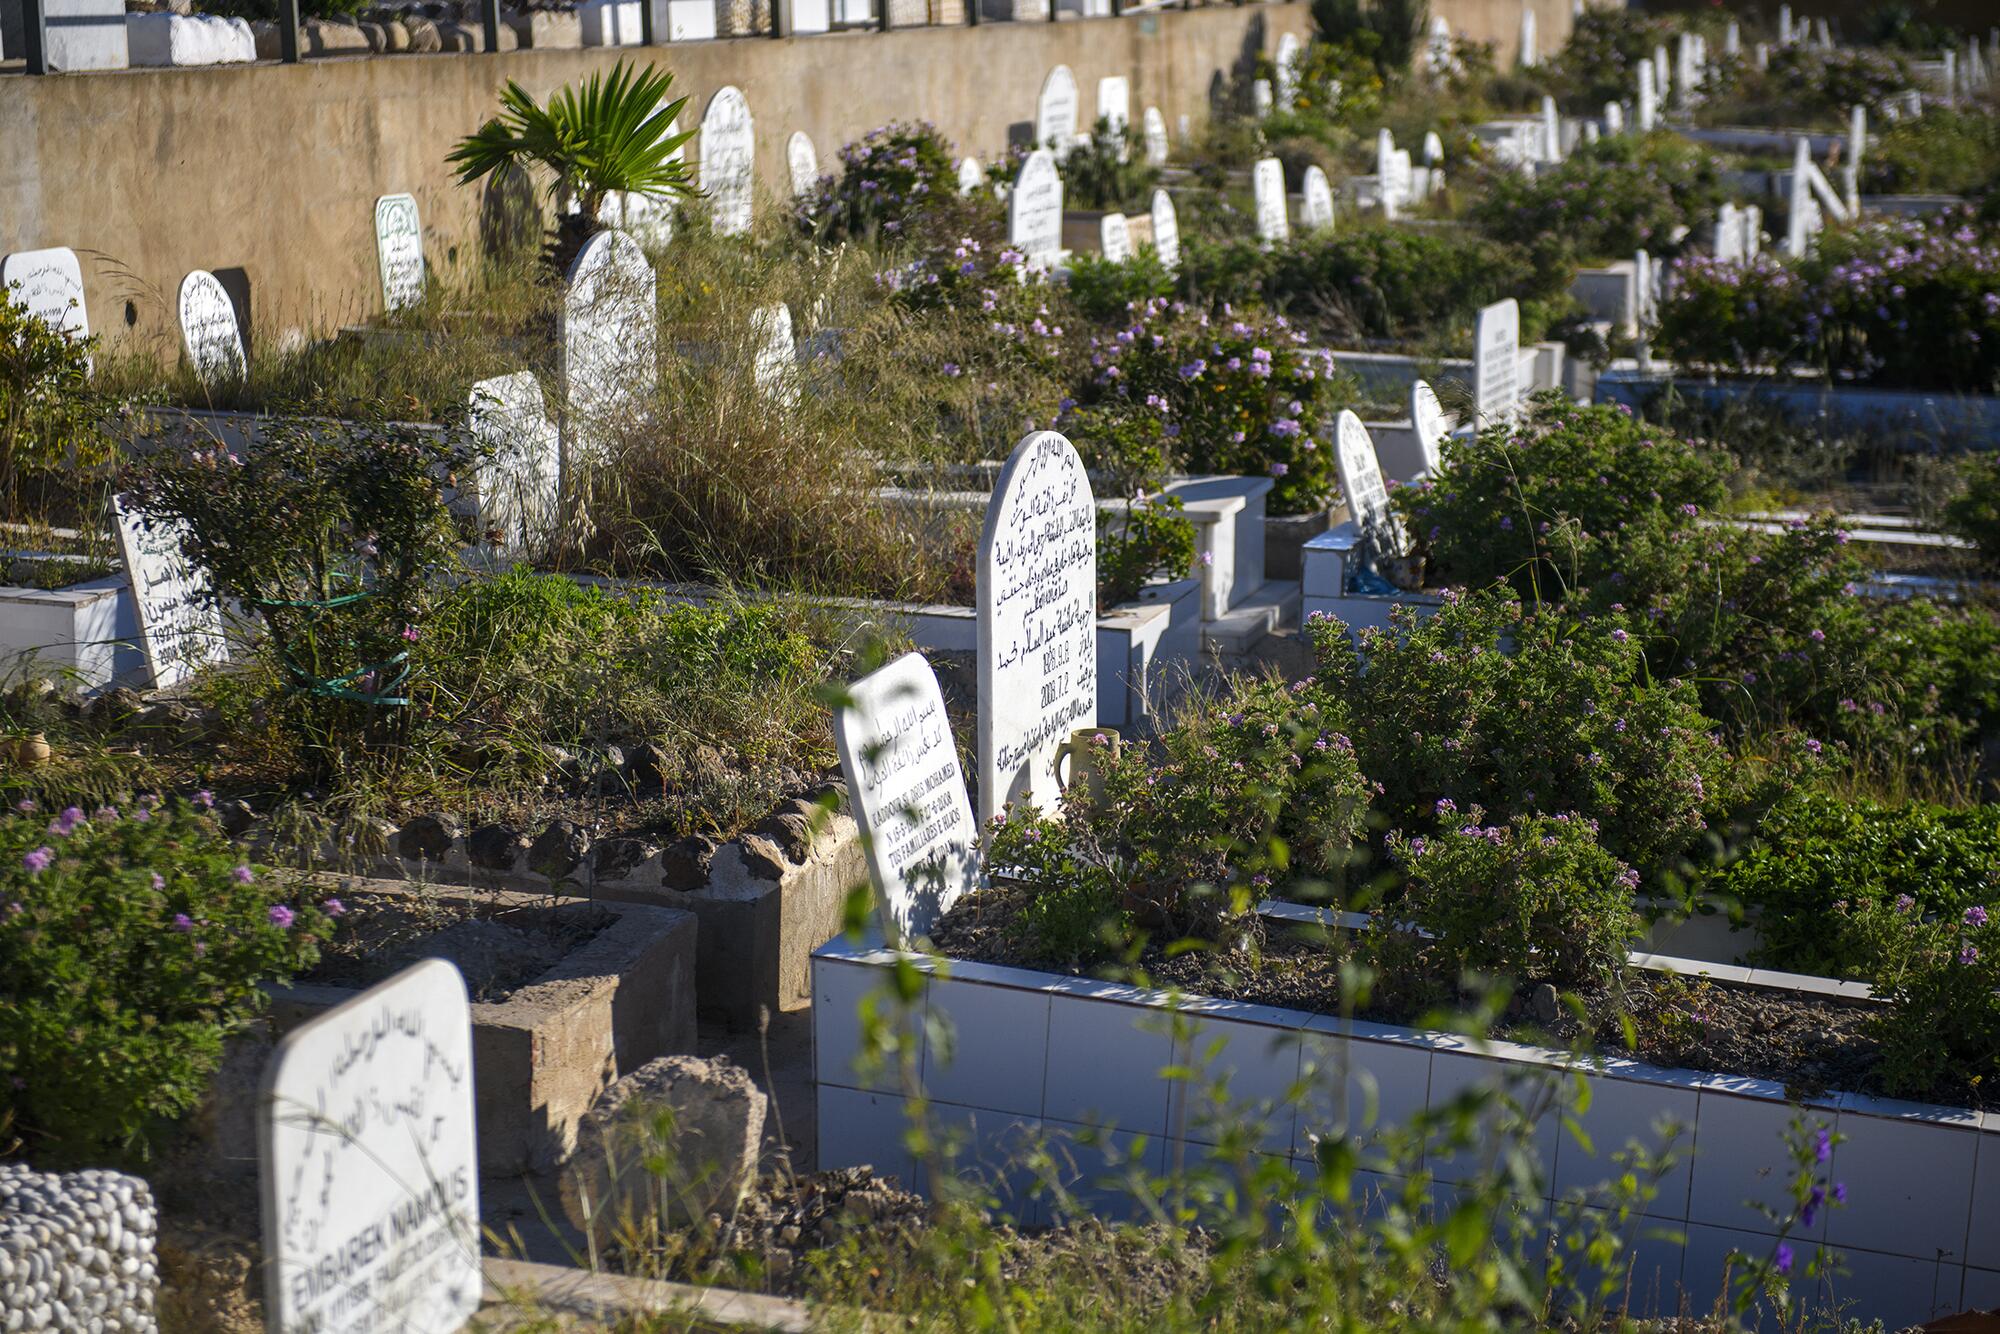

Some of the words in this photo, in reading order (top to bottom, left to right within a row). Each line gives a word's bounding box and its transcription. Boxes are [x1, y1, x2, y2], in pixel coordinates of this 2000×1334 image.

[1041, 671, 1069, 709] 2008.7.2
[925, 762, 956, 793] MOHAMED
[888, 849, 902, 868] TUS
[901, 823, 938, 860] FAMILIARES
[942, 807, 961, 830] HIJOS
